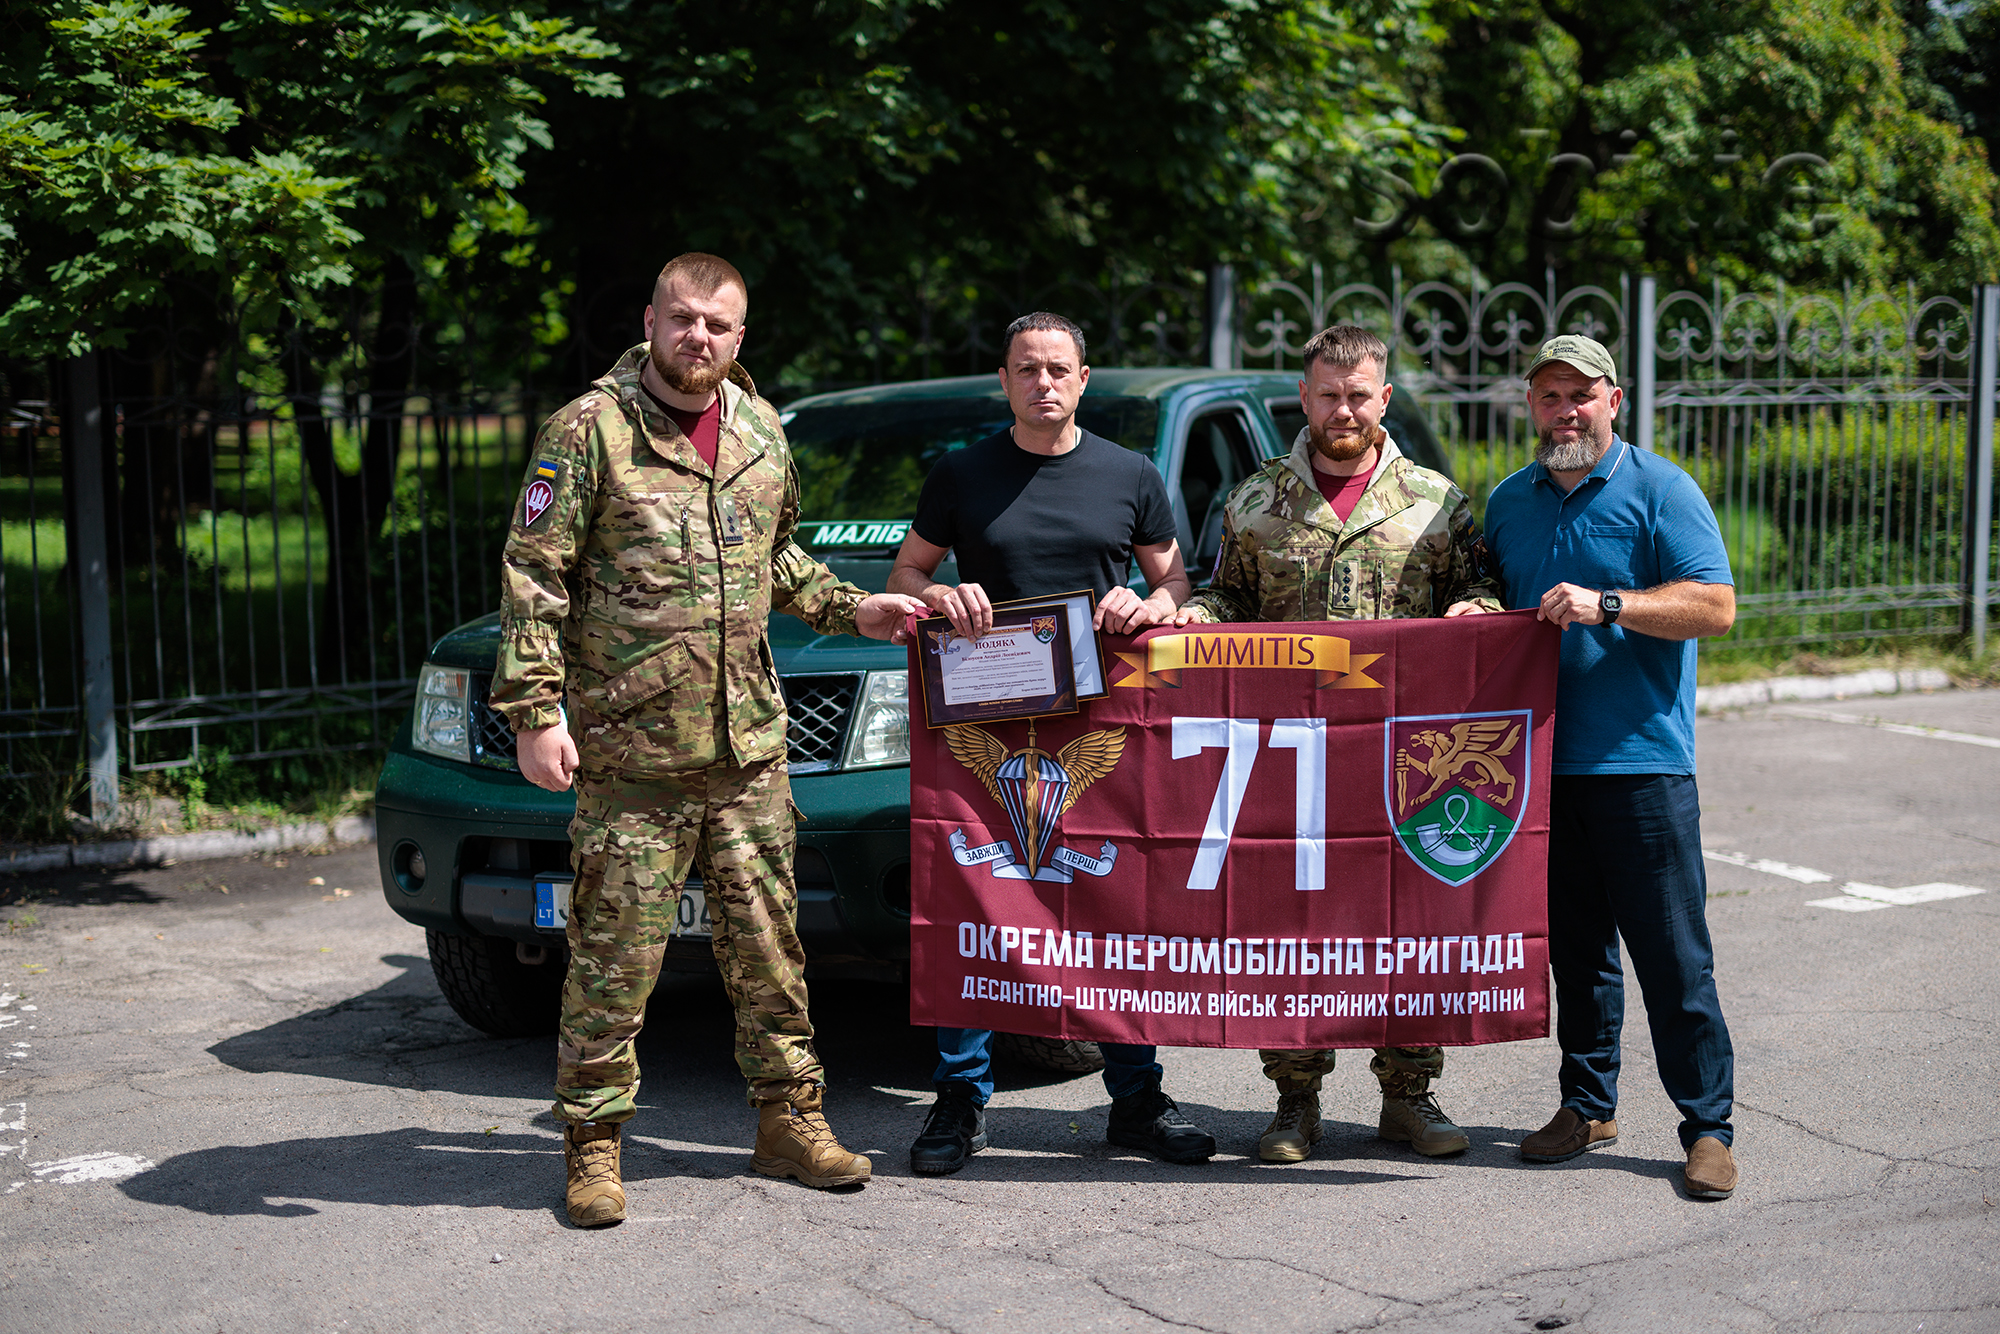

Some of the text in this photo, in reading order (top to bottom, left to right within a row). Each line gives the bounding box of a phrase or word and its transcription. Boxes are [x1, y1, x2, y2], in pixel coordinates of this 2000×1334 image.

[811, 524, 911, 545] МАЛІБ
[975, 638, 1016, 650] ПОДЯКА
[1184, 636, 1315, 666] IMMITIS
[1171, 716, 1327, 891] 71
[964, 843, 1100, 871] ЗАВЖДИ ПЕРШІ
[539, 908, 553, 919] LT
[958, 921, 1525, 976] ОКРЕМА АЕРОМОБІЛЬНА БРИГАДА
[1207, 990, 1277, 1017] ВІЙСЬК
[1283, 990, 1389, 1017] ЗБРОЙНИХ
[1394, 992, 1435, 1017] СИЛ
[1440, 986, 1525, 1016] УКРАЇНИ
